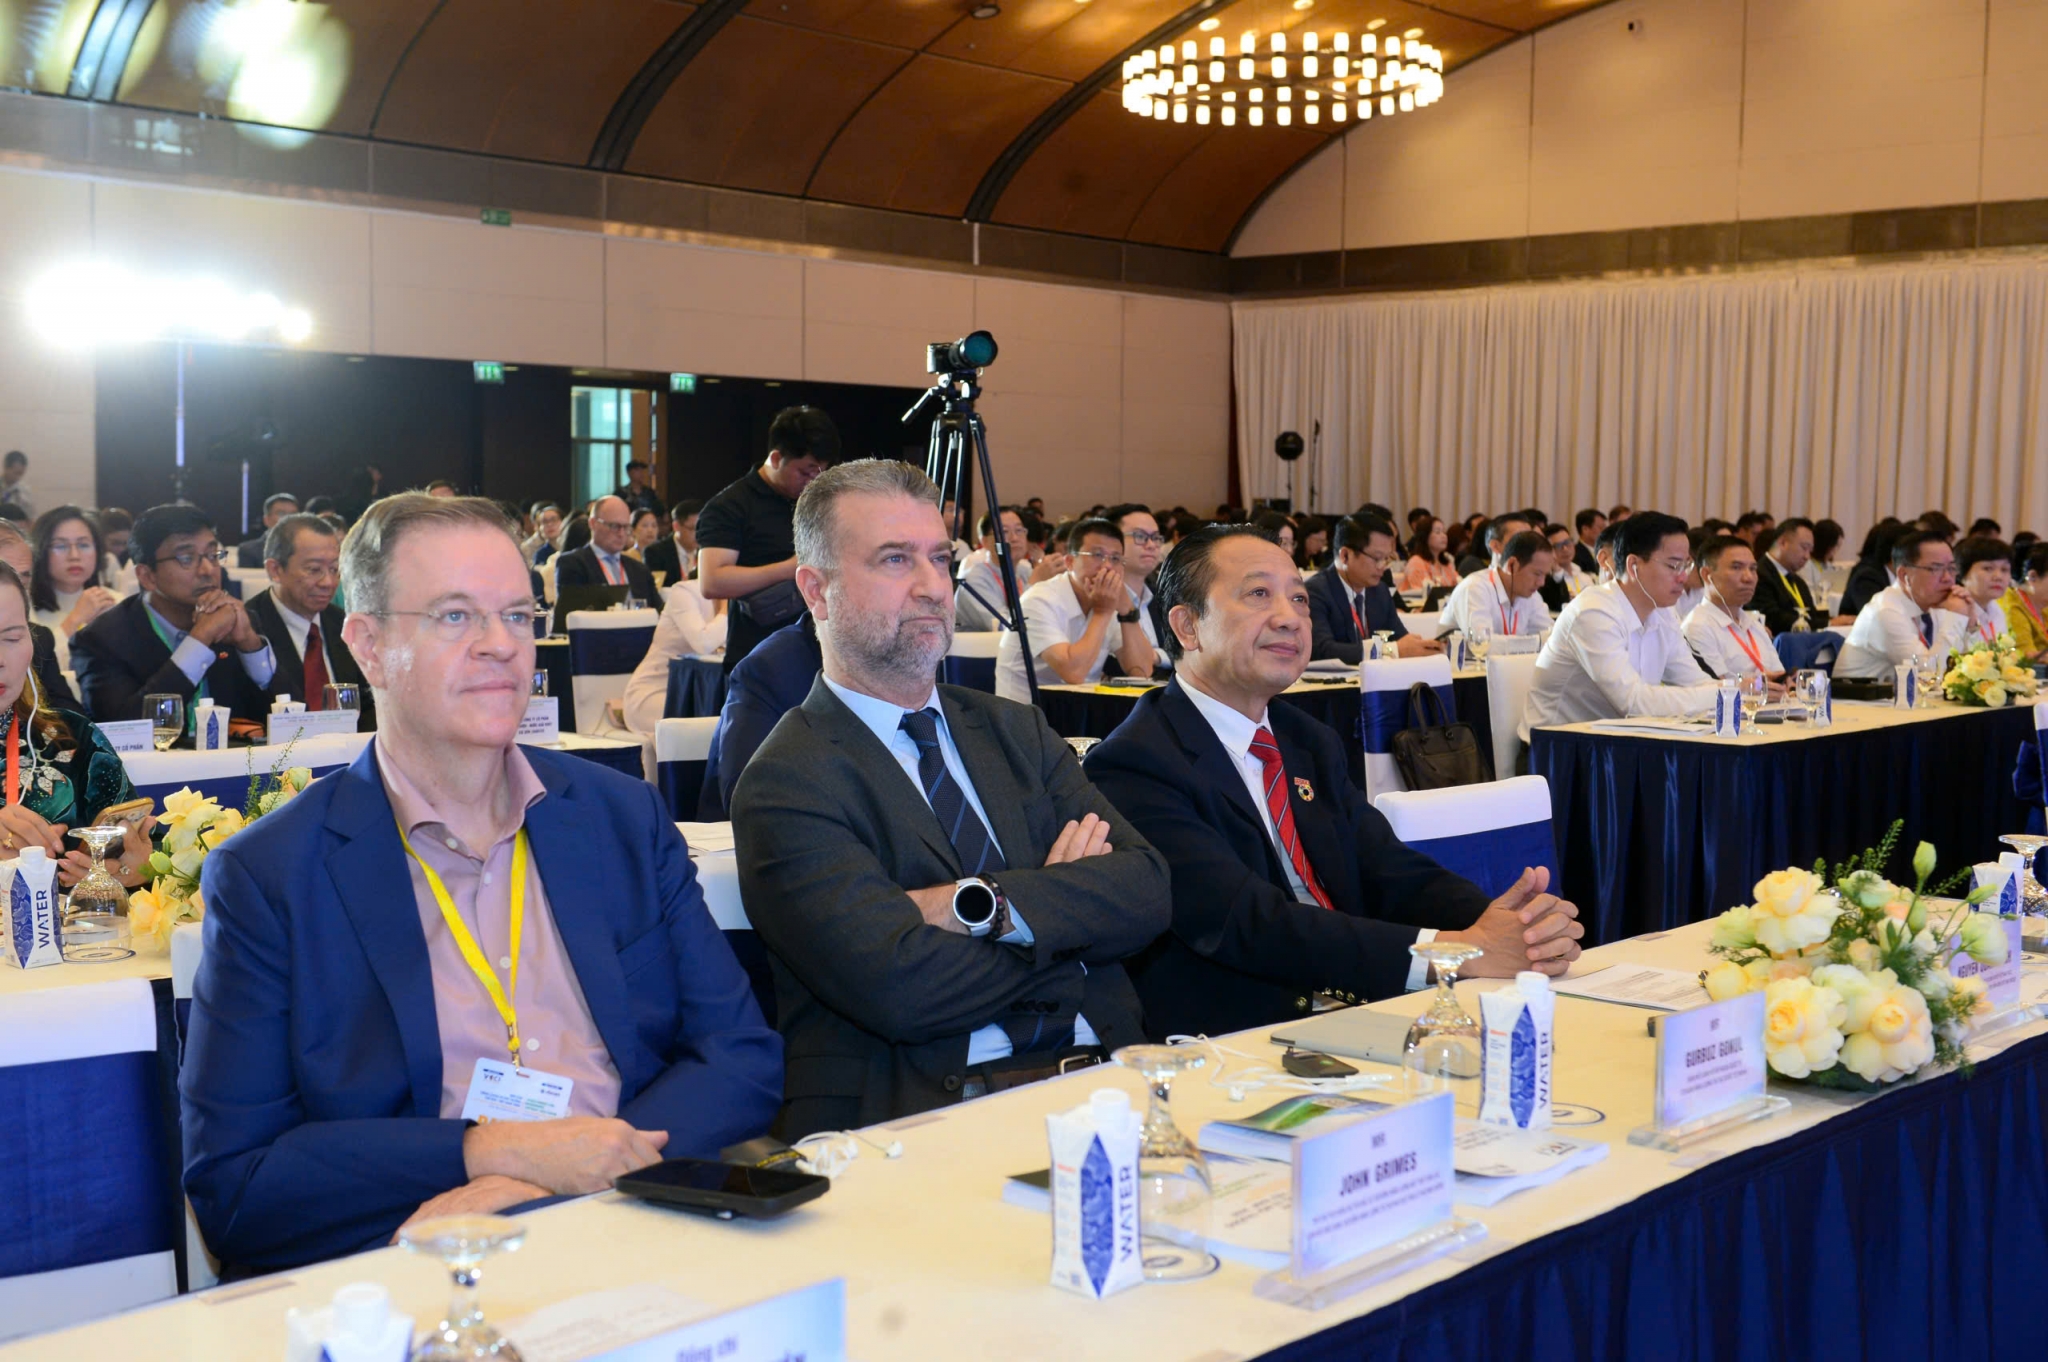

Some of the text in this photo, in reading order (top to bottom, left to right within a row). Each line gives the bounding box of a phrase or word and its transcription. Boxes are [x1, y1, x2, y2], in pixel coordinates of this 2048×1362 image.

[36, 889, 50, 948] WATER
[1539, 1032, 1549, 1109] WATER
[1340, 1151, 1417, 1197] JOHN GRIMES
[1120, 1165, 1133, 1262] WATER
